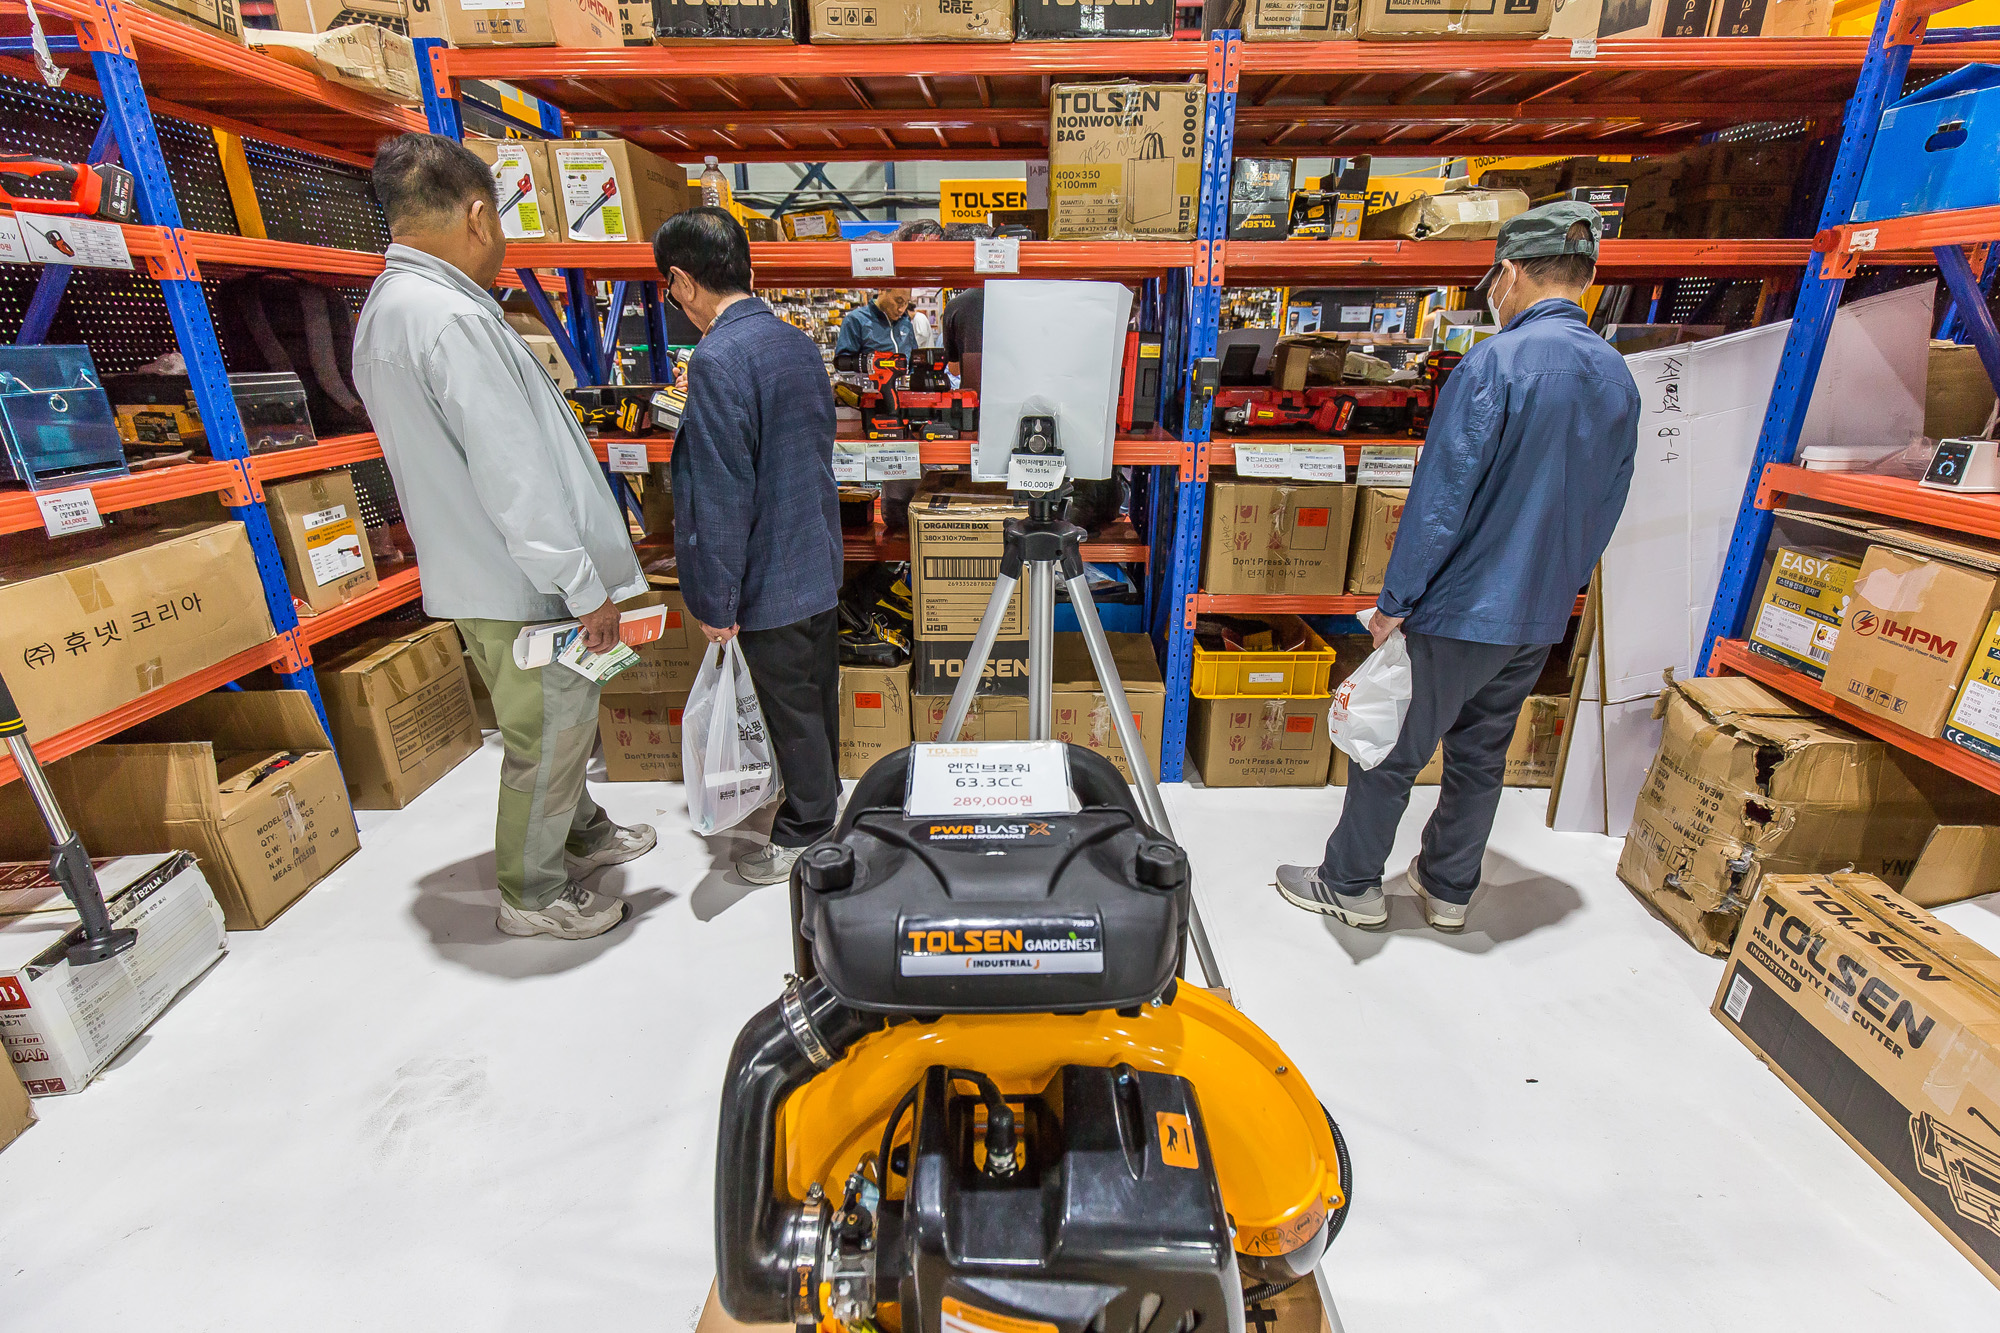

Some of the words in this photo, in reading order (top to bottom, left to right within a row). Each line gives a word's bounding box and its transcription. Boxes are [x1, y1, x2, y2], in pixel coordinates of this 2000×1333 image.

[1056, 90, 1161, 114] TOLSEN
[1057, 114, 1144, 129] NONWOVEN
[1181, 91, 1198, 158] 90005
[1057, 130, 1086, 142] BAG
[1589, 192, 1611, 201] Toolex
[951, 209, 982, 218] TOOLS
[1241, 219, 1276, 229] TOLSEN
[1019, 480, 1055, 489] 160,000원
[923, 522, 971, 530] ORGANIZER
[971, 522, 990, 530] BOX
[1232, 557, 1256, 567] Don't
[1257, 557, 1284, 567] Press
[1284, 557, 1291, 567] &
[1294, 557, 1322, 567] Throw
[1780, 551, 1829, 579] EASY
[1779, 598, 1789, 608] NO
[1788, 601, 1801, 611] GAS
[63, 619, 123, 657] 휴넷
[130, 592, 203, 633] 코리아
[1880, 618, 1958, 659] IHPM
[1904, 644, 1915, 653] High
[1915, 648, 1929, 657] Power
[1928, 653, 1949, 664] Machine
[654, 660, 662, 668] &
[663, 660, 690, 668] Throw
[624, 752, 646, 760] Don't
[647, 752, 670, 760] Press
[671, 752, 679, 760] &
[1229, 757, 1251, 765] Don't
[1251, 757, 1275, 765] Press
[1276, 757, 1283, 765] &
[1285, 757, 1310, 765] Throw
[947, 762, 1031, 774] 엔진브로워
[955, 777, 1023, 788] 63.3CC
[953, 795, 1033, 808] 289,000원
[304, 820, 315, 832] KG
[329, 826, 340, 838] CM
[260, 832, 278, 848] QTY:
[307, 831, 318, 843] KG
[929, 833, 967, 841] SUPERIOR
[967, 833, 1026, 841] PERFORMANCE
[133, 876, 163, 901] TB21LM
[1796, 885, 1952, 982] TOLSEN
[907, 929, 1023, 953] TOLSEN
[1024, 938, 1097, 952] GARDENEST
[972, 959, 1033, 968] INDUSTRIAL
[1750, 944, 1797, 990] INDUSTRIAL
[1762, 894, 1937, 1050] TOLSEN
[1752, 925, 1789, 962] HEAVY
[1790, 961, 1823, 992] DUTY
[1824, 985, 1851, 1014] TILE
[1851, 1010, 1906, 1060] CUTTER
[4, 1012, 27, 1020] Mower
